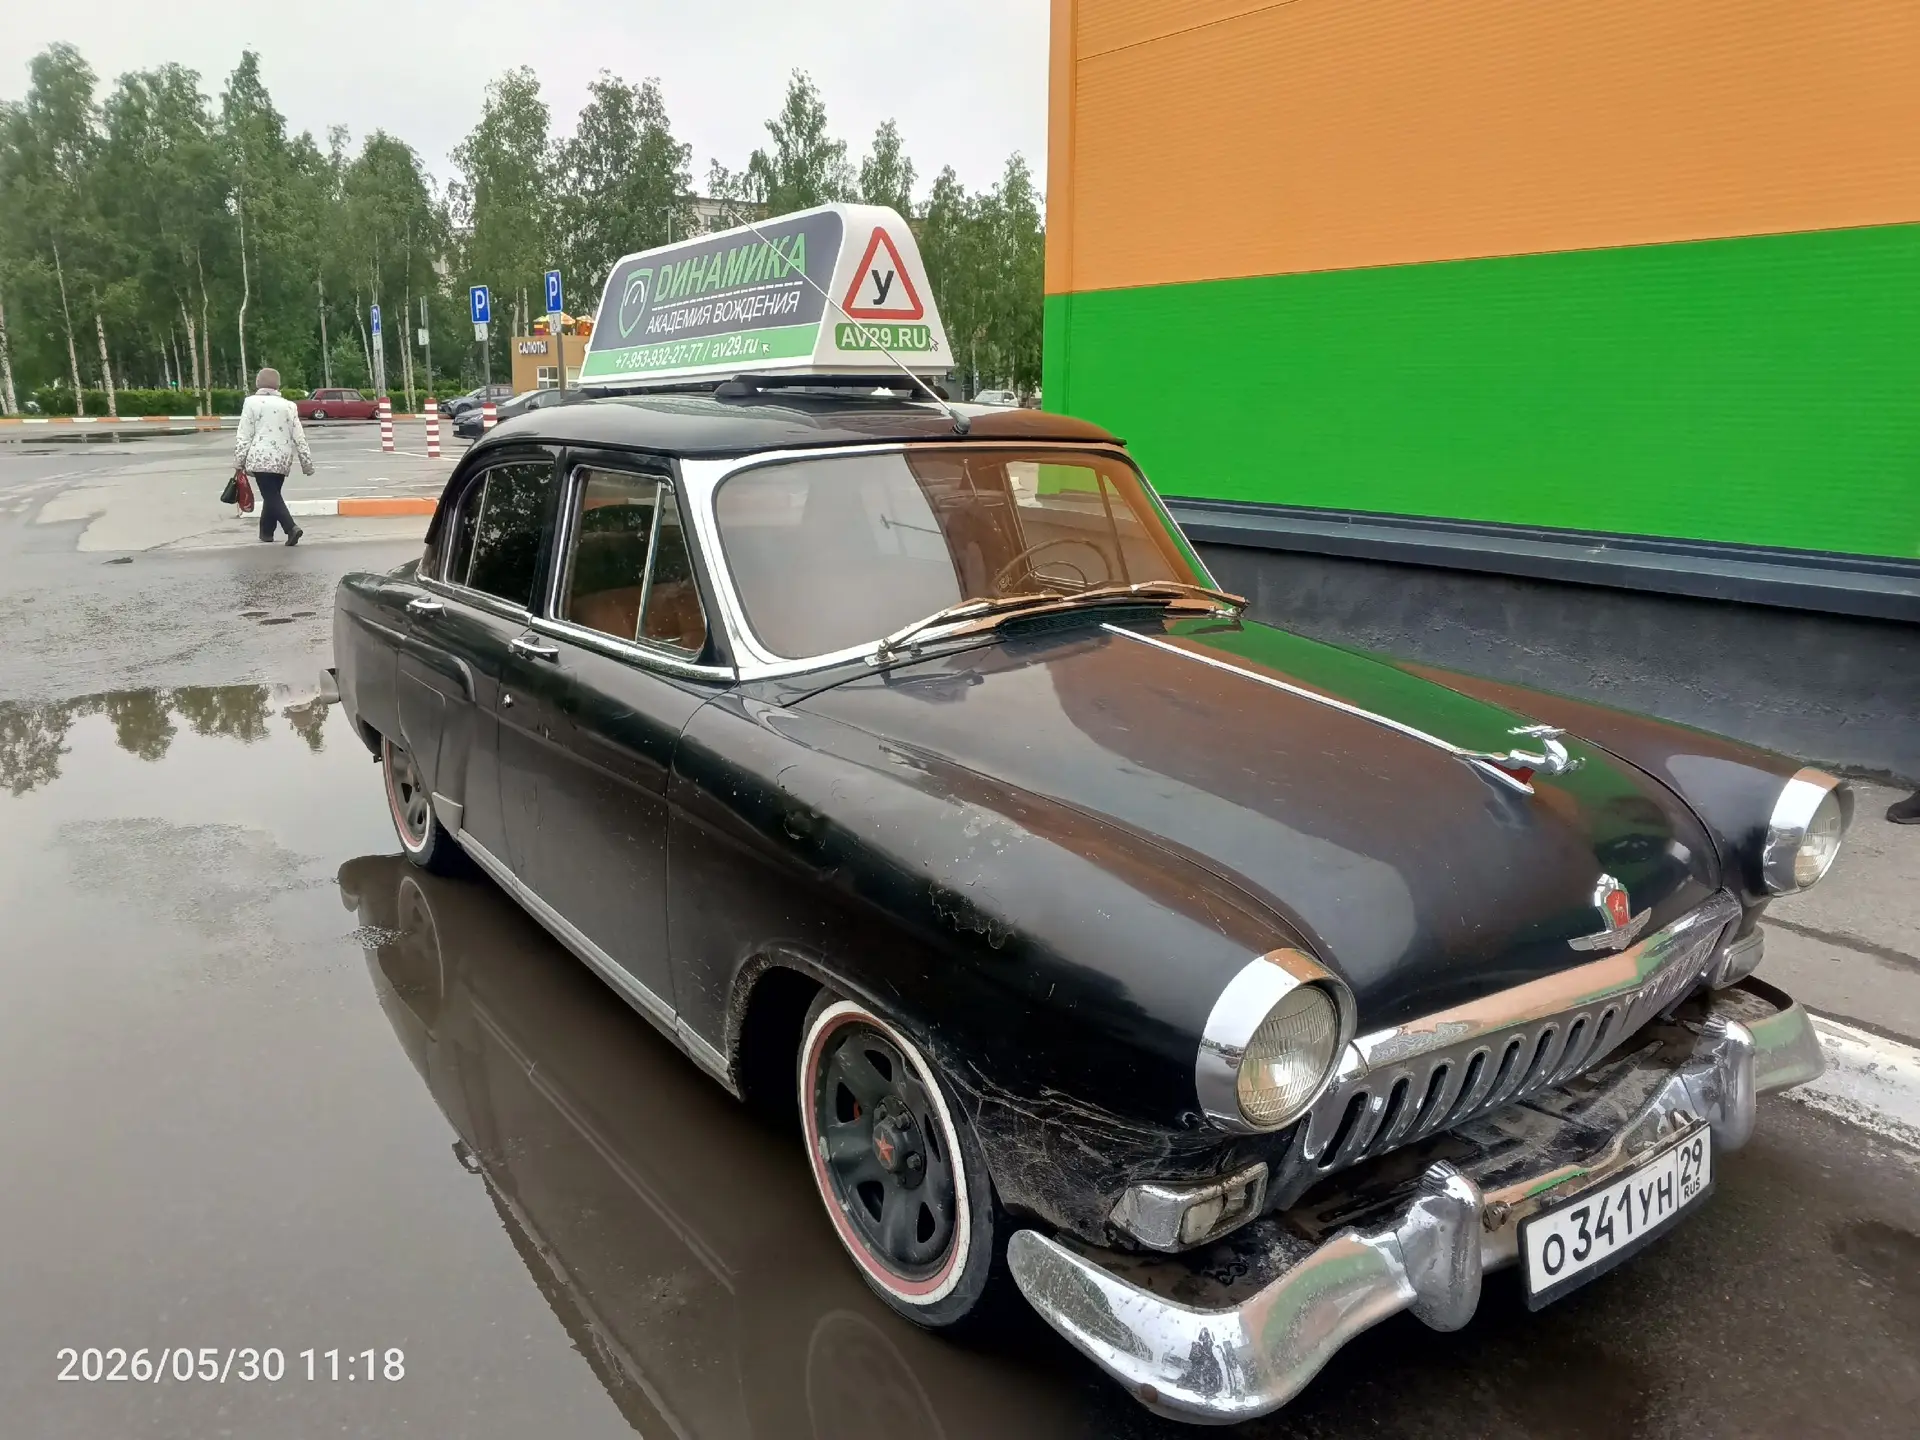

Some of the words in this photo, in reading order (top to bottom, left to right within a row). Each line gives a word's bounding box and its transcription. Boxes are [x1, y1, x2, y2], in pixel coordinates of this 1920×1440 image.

[548, 276, 558, 307] P
[871, 268, 895, 305] У
[475, 290, 485, 319] P
[645, 304, 712, 335] АКАДЕМИЯ
[713, 290, 801, 323] ВОЖДЕНИЯ
[615, 342, 703, 369] +7-953-932-27-77
[711, 335, 760, 358] av29.ru
[841, 326, 927, 348] AV29.RU
[1679, 1137, 1704, 1187] 29
[1683, 1176, 1702, 1201] RUS
